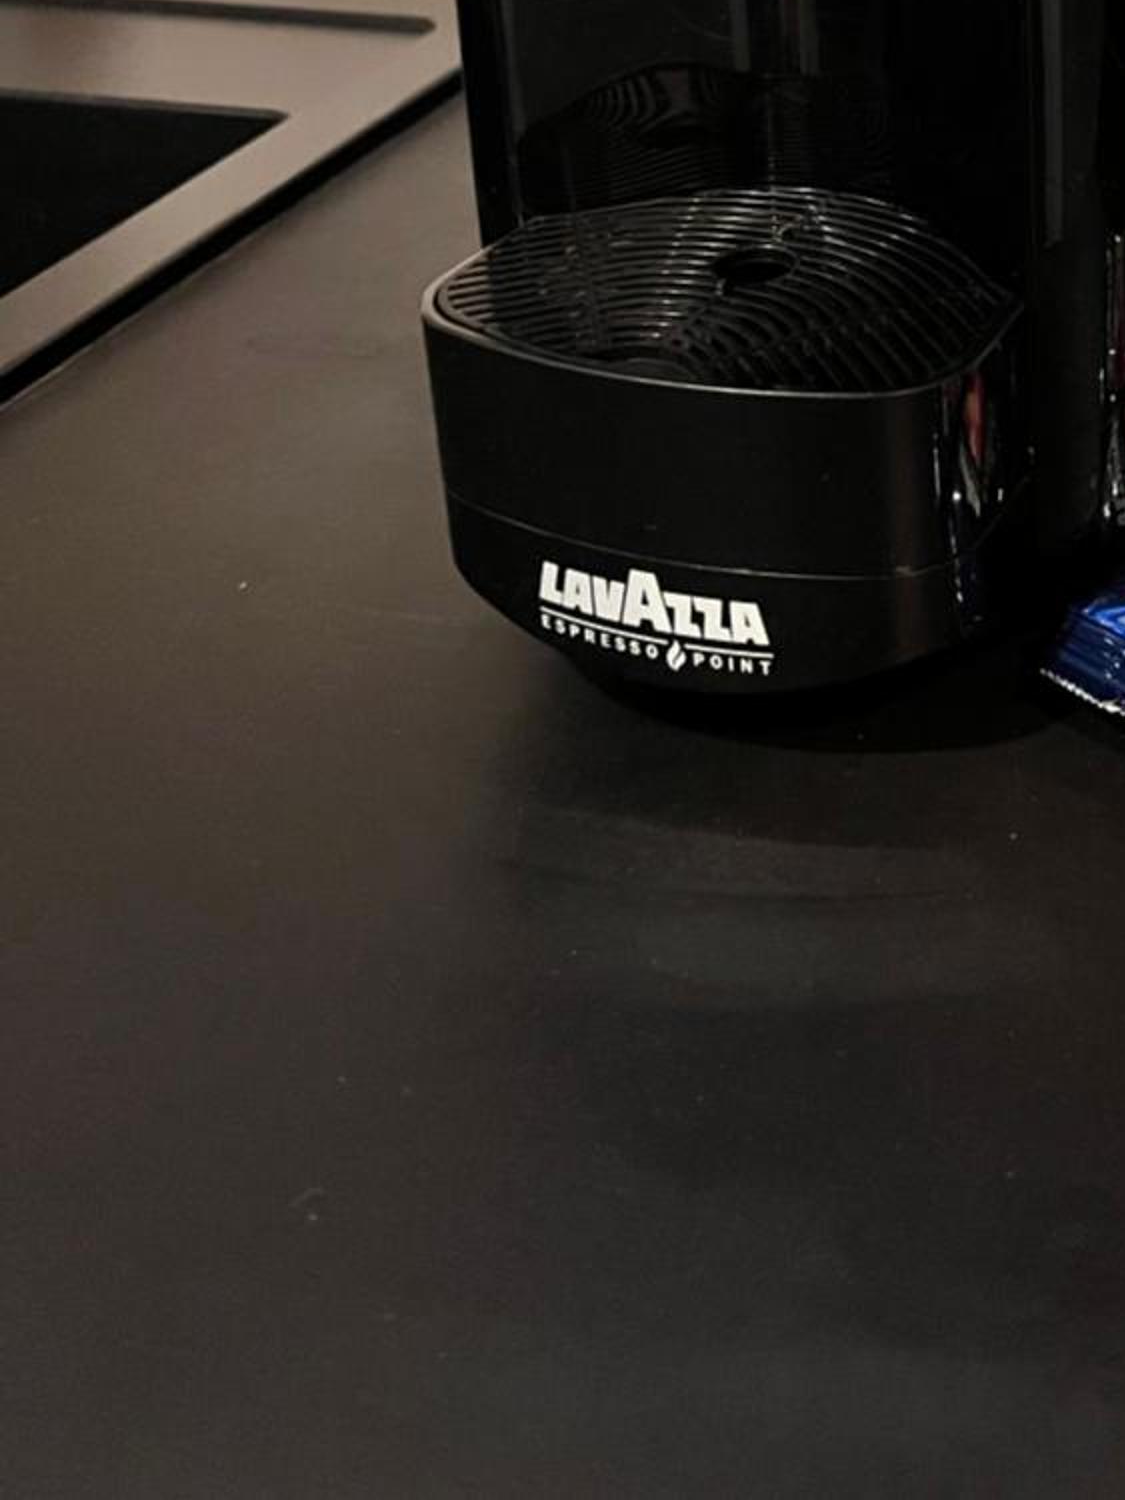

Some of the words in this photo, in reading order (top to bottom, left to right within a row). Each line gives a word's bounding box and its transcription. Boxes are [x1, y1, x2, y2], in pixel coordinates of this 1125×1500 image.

[539, 560, 770, 646] LAVAZZA
[541, 613, 660, 660] ESPRESSO
[692, 652, 772, 676] POINT
